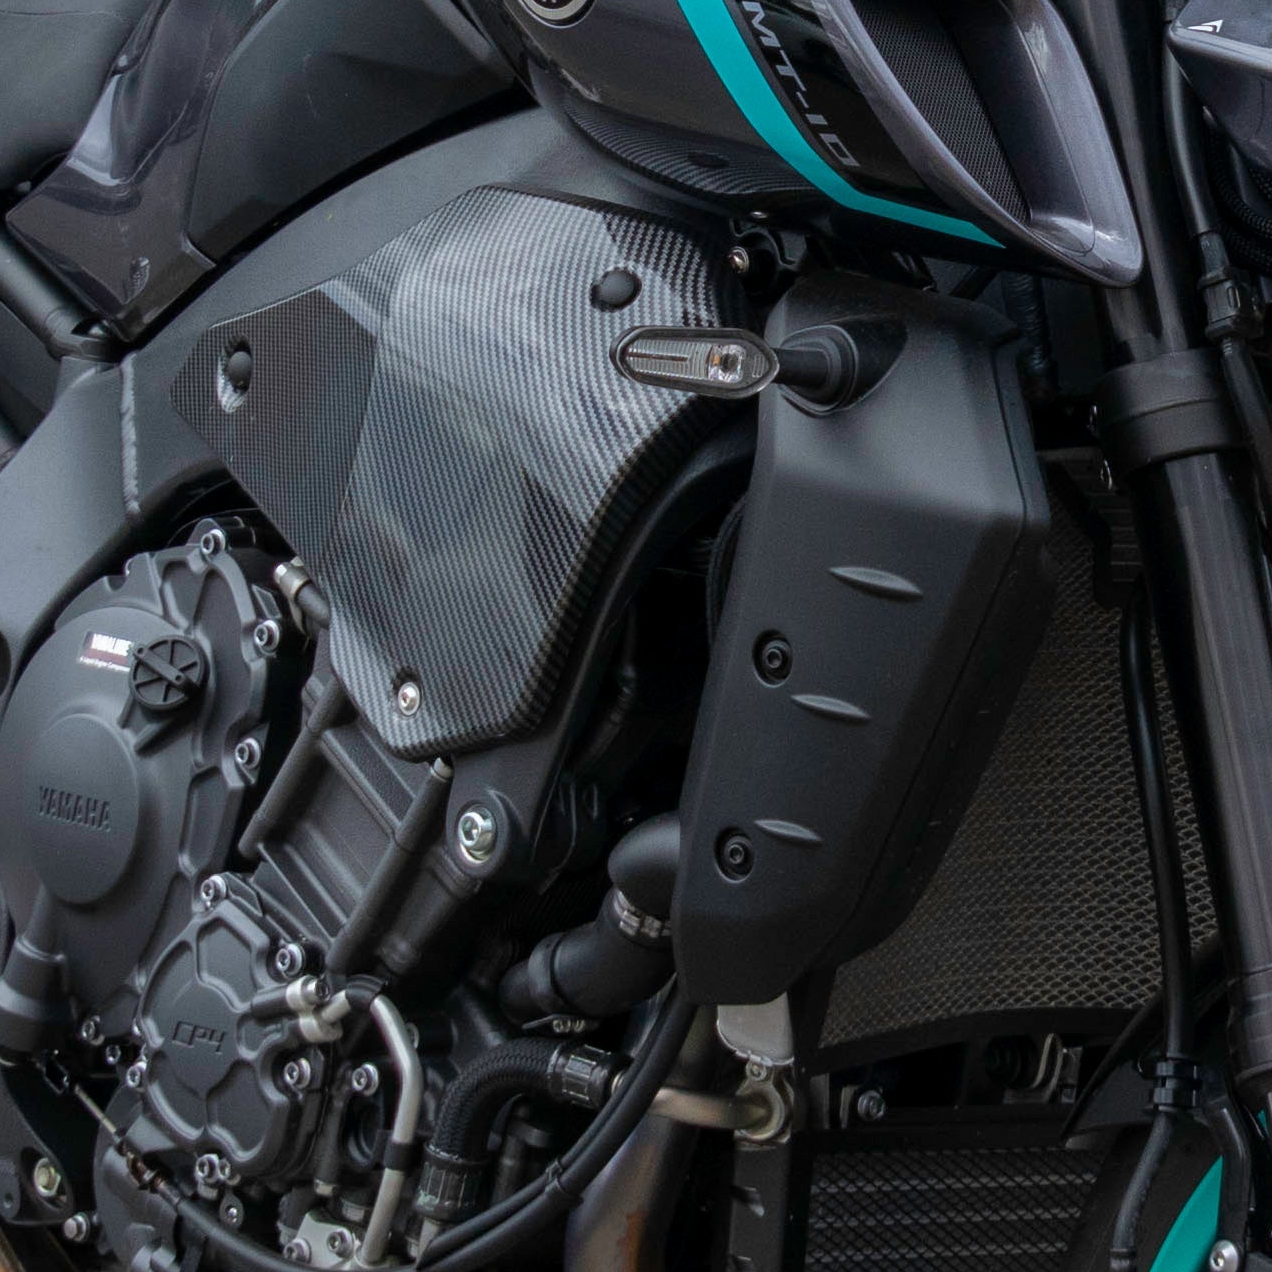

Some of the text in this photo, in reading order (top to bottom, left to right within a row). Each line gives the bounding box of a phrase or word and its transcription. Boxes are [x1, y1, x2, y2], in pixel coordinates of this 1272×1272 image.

[741, 0, 862, 169] MT-10
[38, 784, 112, 833] YAMAHA
[172, 1019, 226, 1055] CP4
